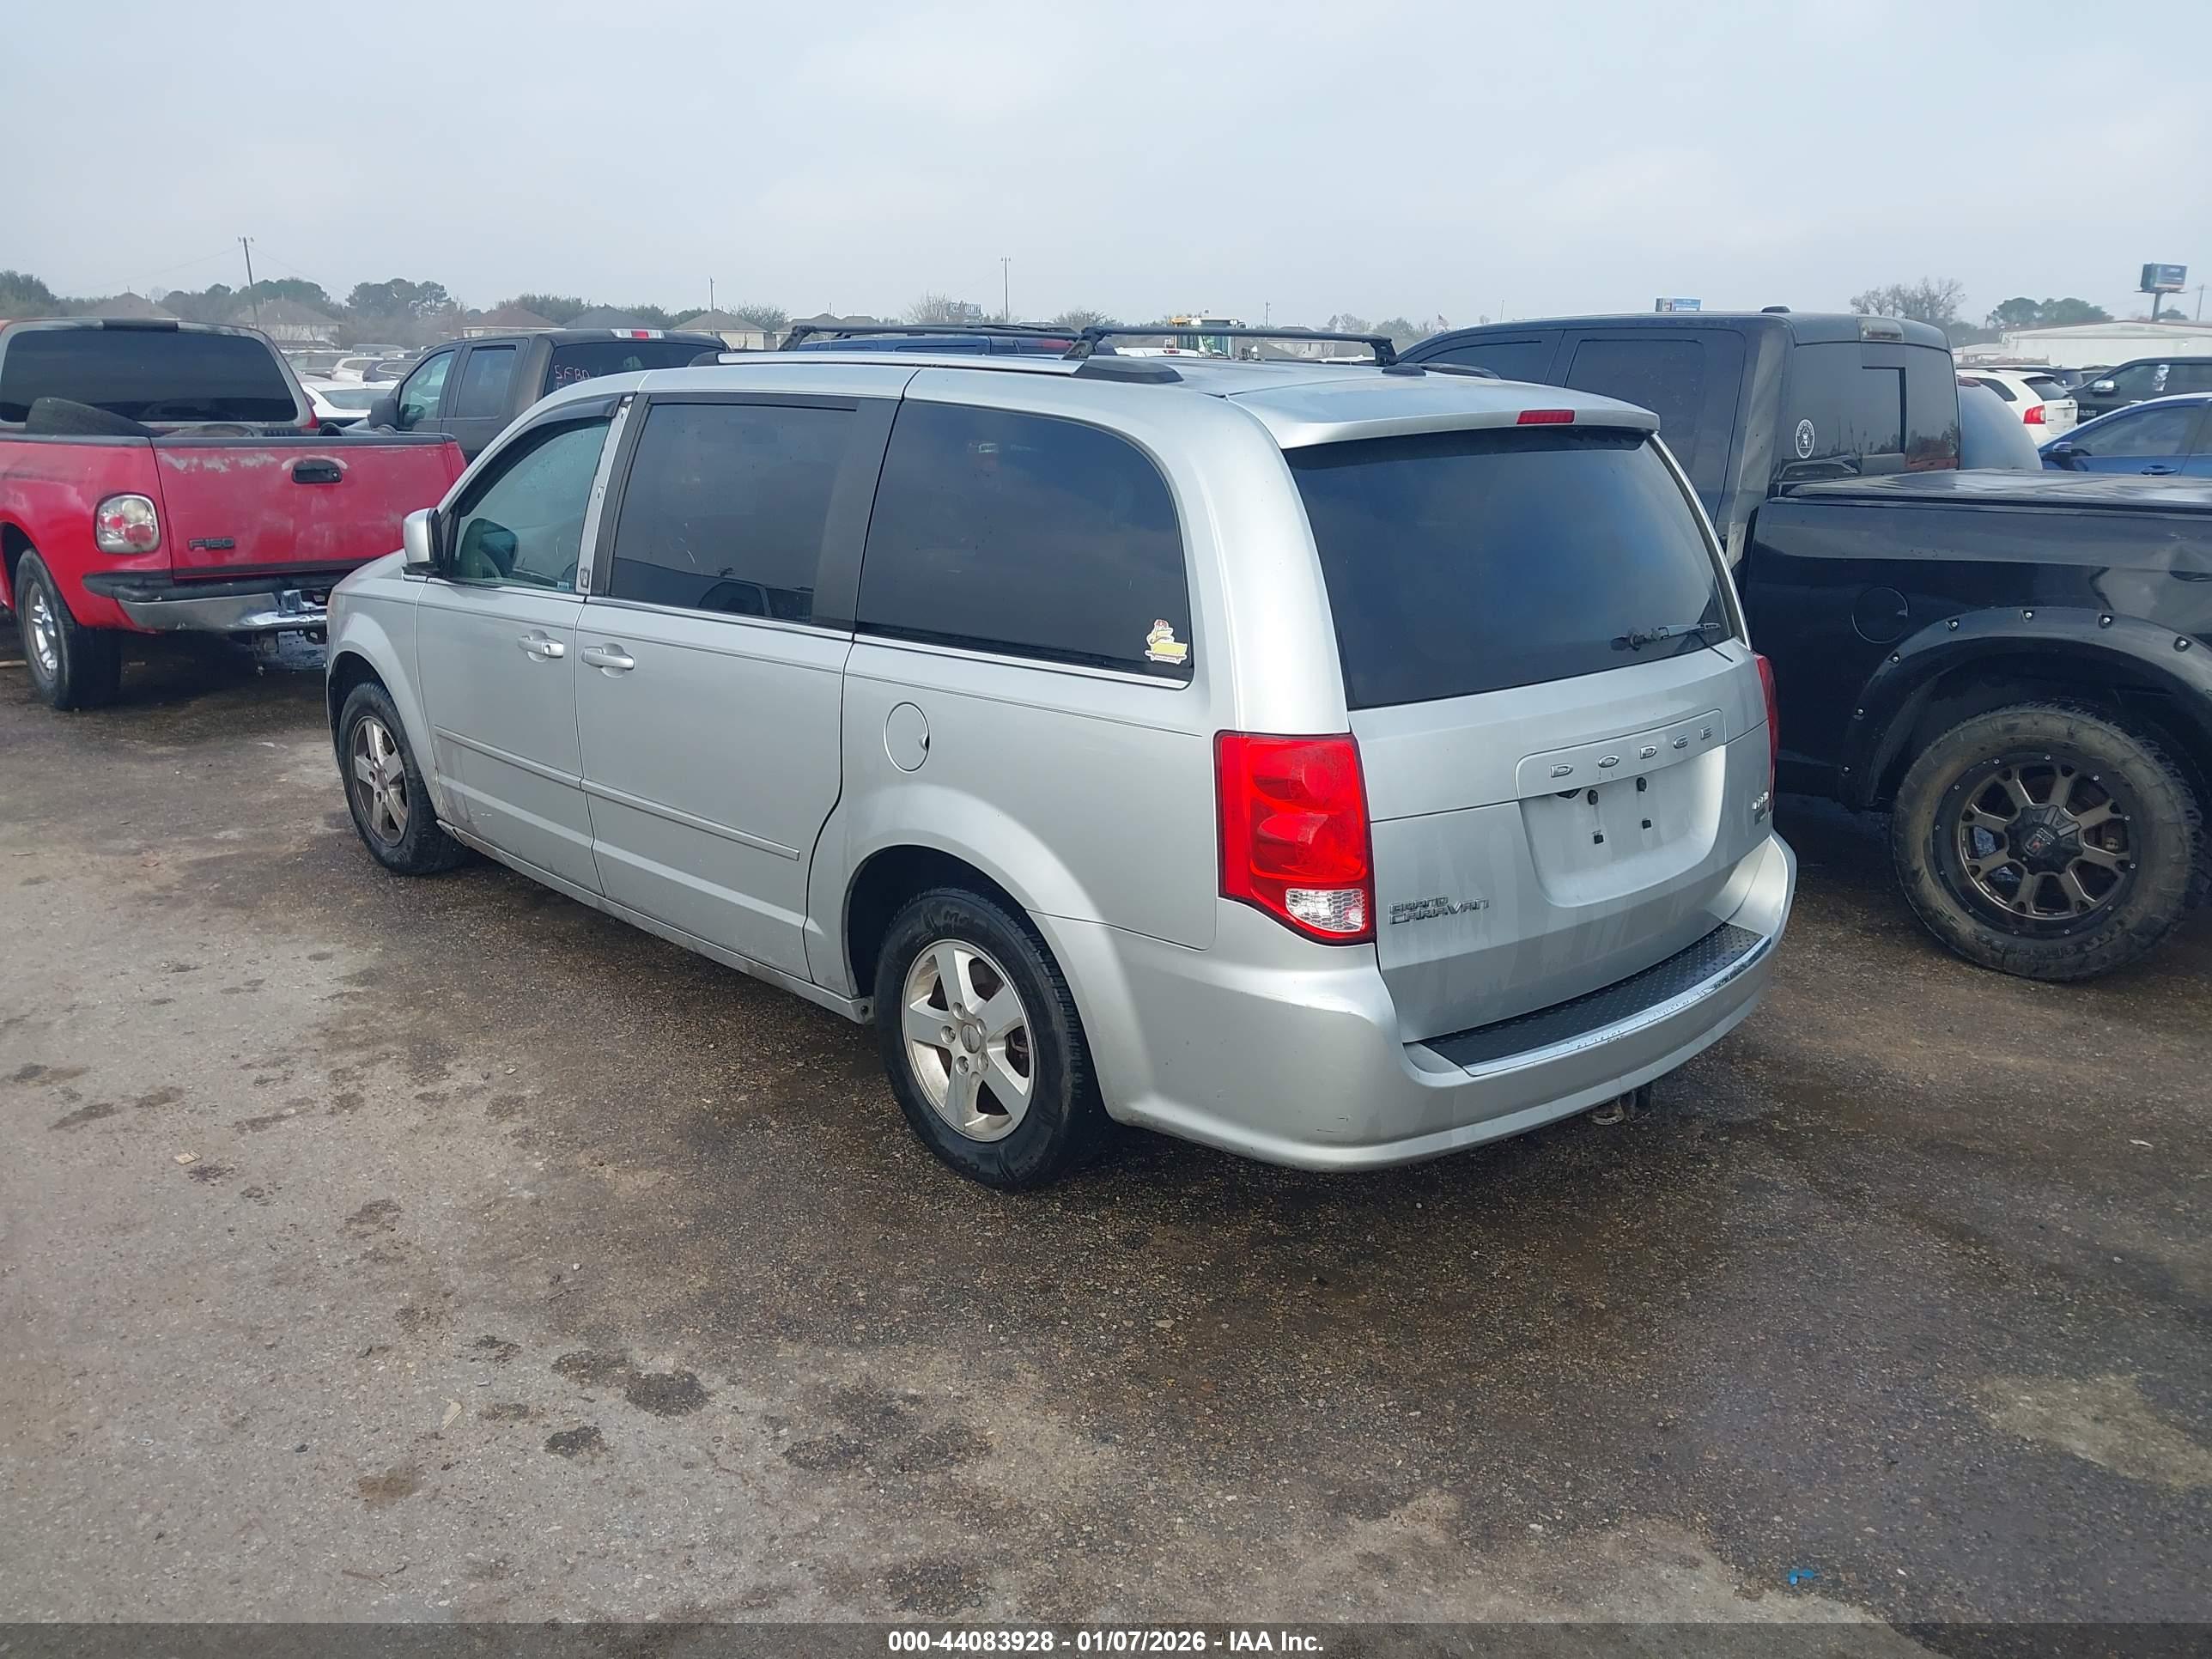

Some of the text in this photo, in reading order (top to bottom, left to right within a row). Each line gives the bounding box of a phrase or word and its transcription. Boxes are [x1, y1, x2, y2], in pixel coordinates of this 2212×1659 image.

[1550, 726, 1712, 778] DODGE
[1389, 897, 1449, 915] GRAND
[1389, 899, 1490, 925] CARAVAN
